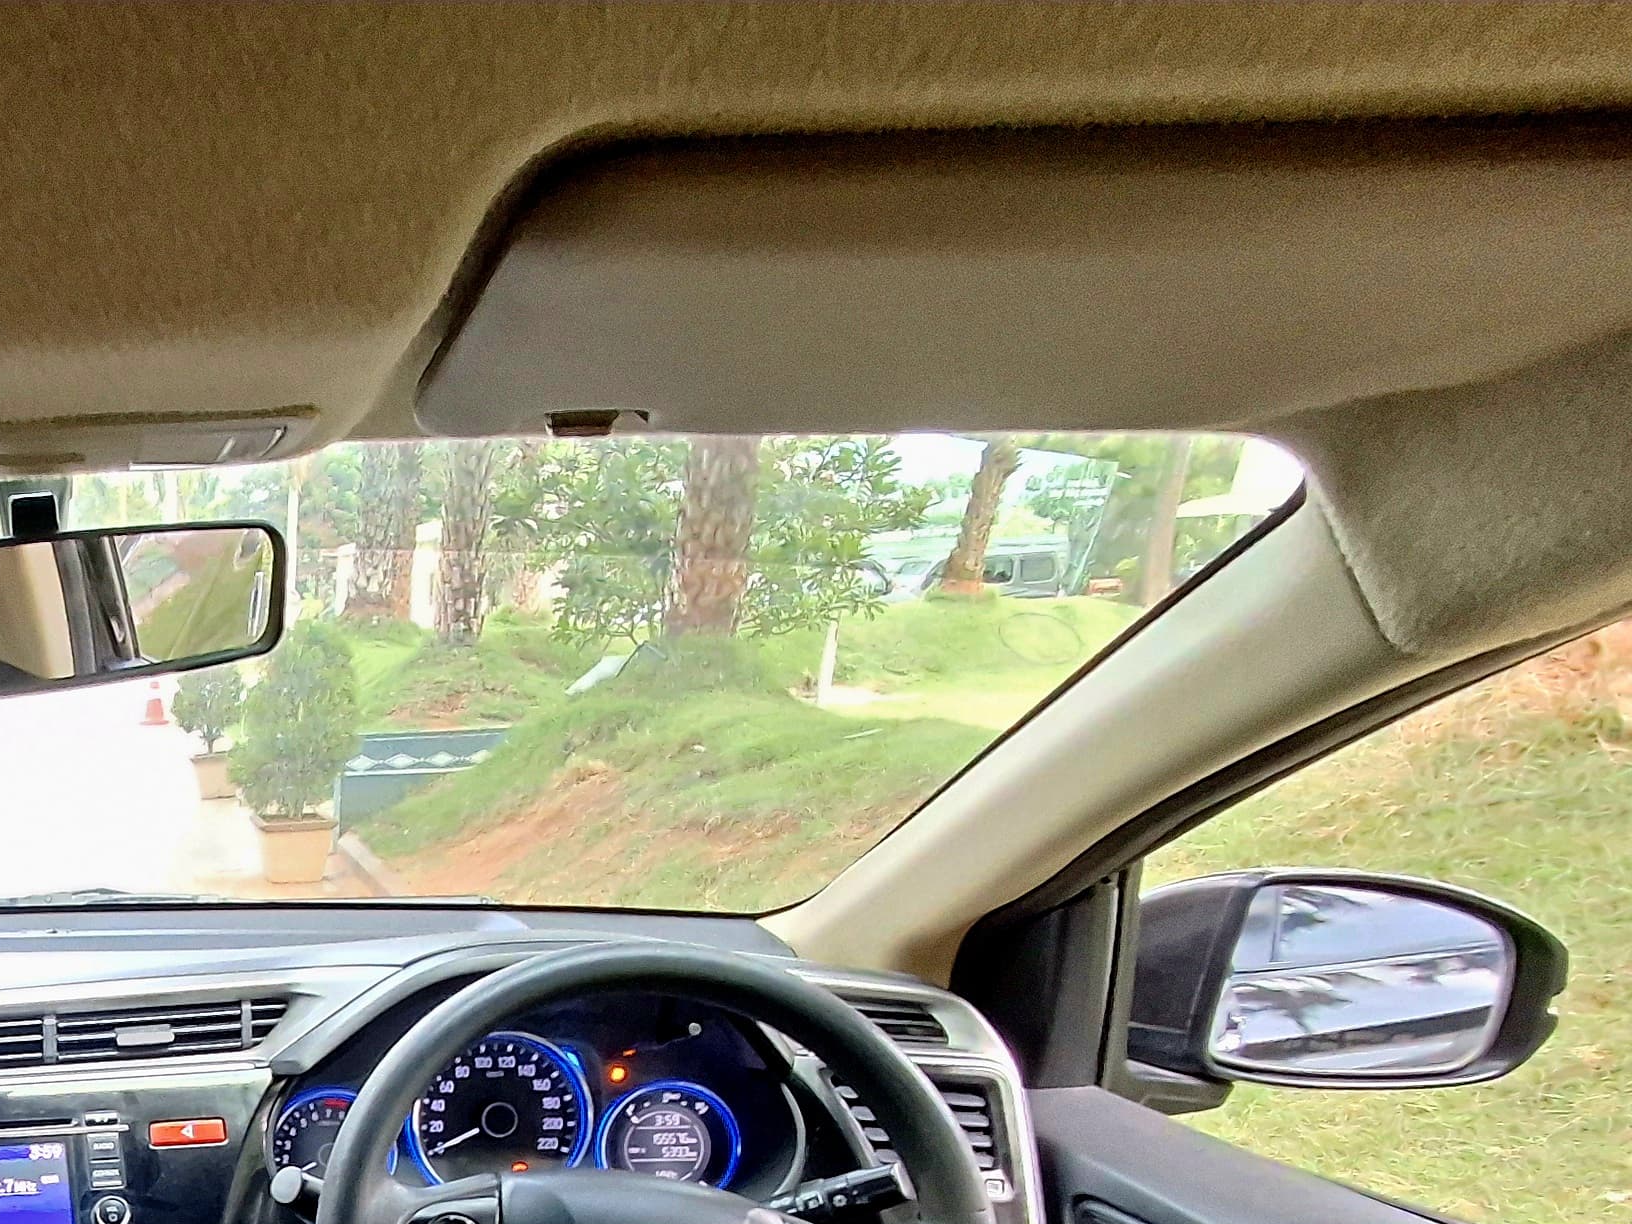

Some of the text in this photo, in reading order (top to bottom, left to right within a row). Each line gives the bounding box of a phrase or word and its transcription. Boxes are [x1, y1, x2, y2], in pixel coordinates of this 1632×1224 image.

[475, 1057, 492, 1068] 100
[498, 1056, 515, 1068] 120
[455, 1066, 470, 1078] 80
[518, 1064, 536, 1077] 140
[439, 1080, 454, 1093] 60
[431, 1099, 445, 1112] 40
[429, 1120, 443, 1132] 20
[542, 1117, 563, 1130] 200
[655, 1113, 680, 1126] 3:59
[537, 1138, 558, 1150] 220
[28, 1143, 62, 1161] 3:59
